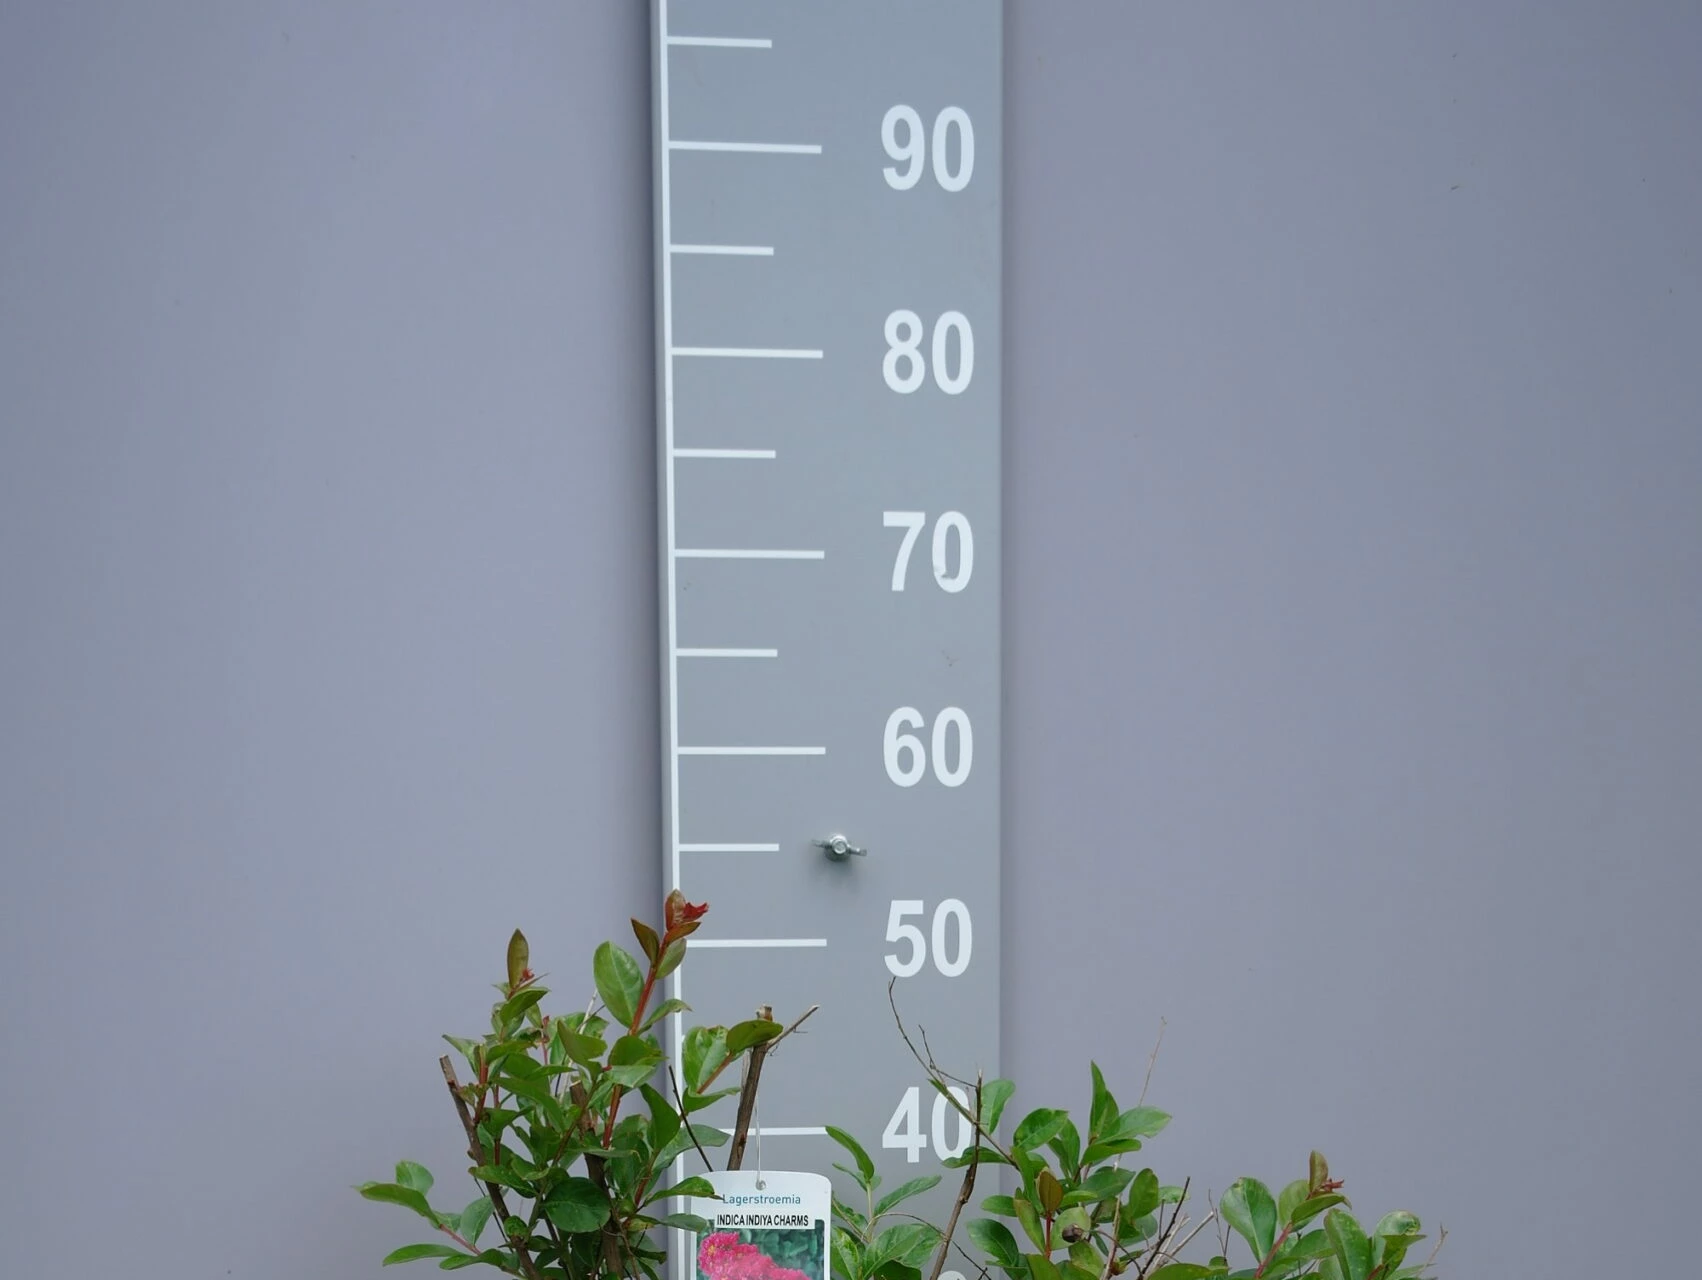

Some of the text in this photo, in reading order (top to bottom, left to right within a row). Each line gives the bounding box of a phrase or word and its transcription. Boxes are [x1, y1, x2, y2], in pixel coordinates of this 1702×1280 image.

[881, 105, 975, 192] 90
[882, 309, 974, 395] 80
[883, 510, 974, 593] 70
[883, 706, 973, 787] 60
[884, 898, 973, 978] 50
[882, 1086, 972, 1163] 40
[717, 1214, 809, 1226] INDICA INDIYA CHARMS
[723, 1194, 801, 1206] Lagerstroemia
